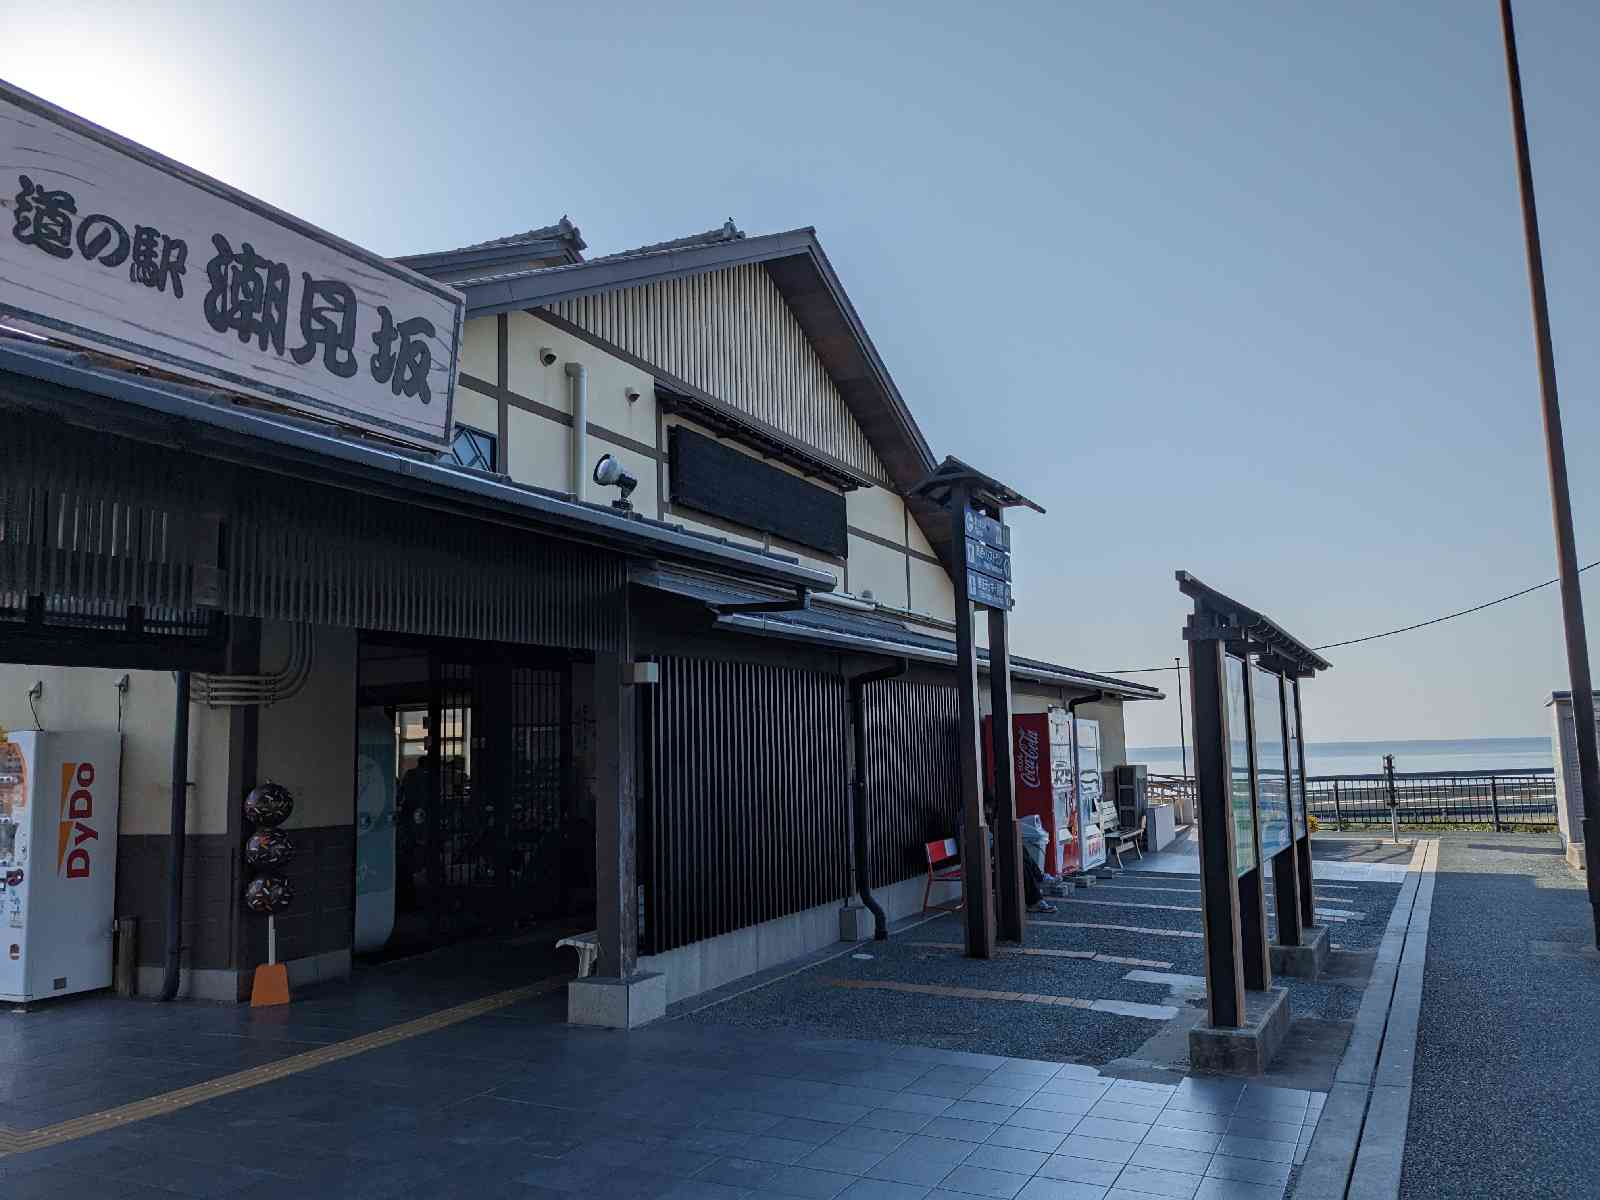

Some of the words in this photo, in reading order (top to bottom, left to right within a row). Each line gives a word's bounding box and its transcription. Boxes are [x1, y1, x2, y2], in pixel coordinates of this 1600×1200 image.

[13, 174, 189, 299] 道の駅
[203, 233, 436, 404] 潮見坂
[1019, 728, 1041, 789] Coca-Cola
[66, 762, 99, 878] DyDo
